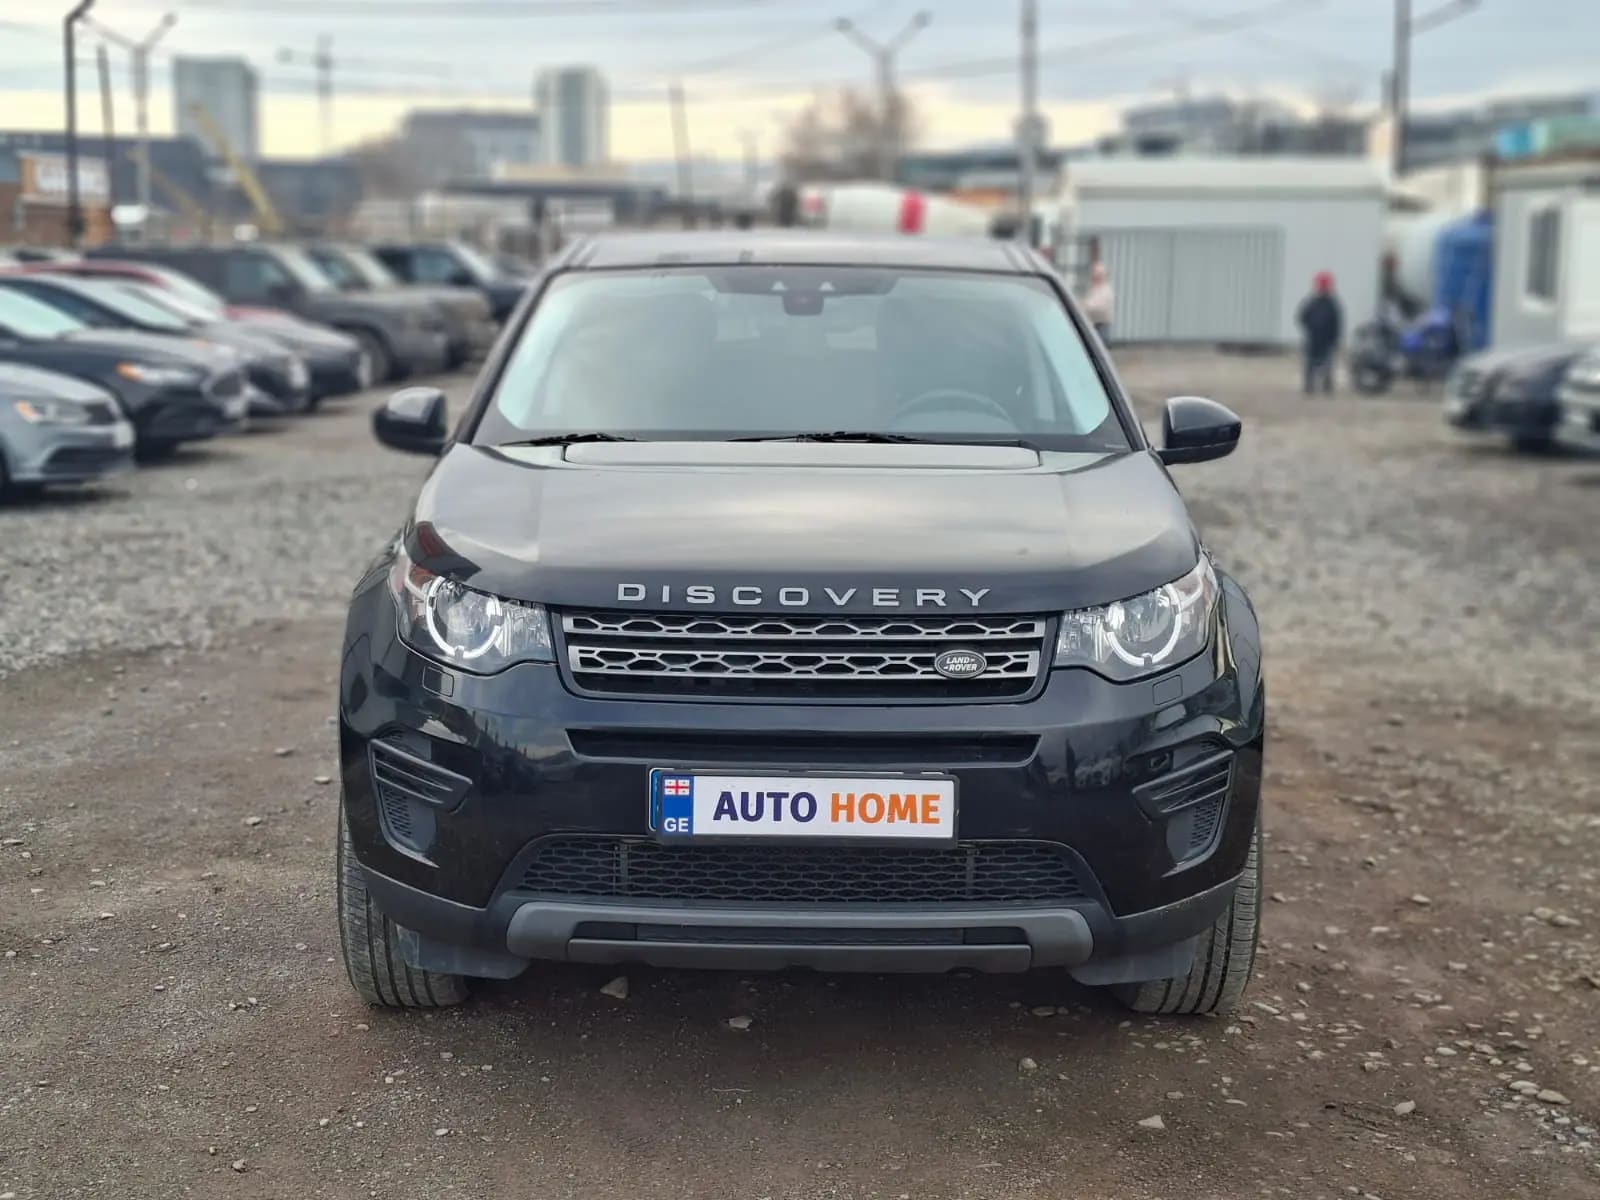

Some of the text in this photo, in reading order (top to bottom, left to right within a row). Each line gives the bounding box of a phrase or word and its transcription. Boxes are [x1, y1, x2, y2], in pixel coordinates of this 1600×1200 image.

[617, 583, 990, 606] DISCOVERY
[713, 791, 940, 823] AUTO HOME
[663, 817, 689, 832] GE
